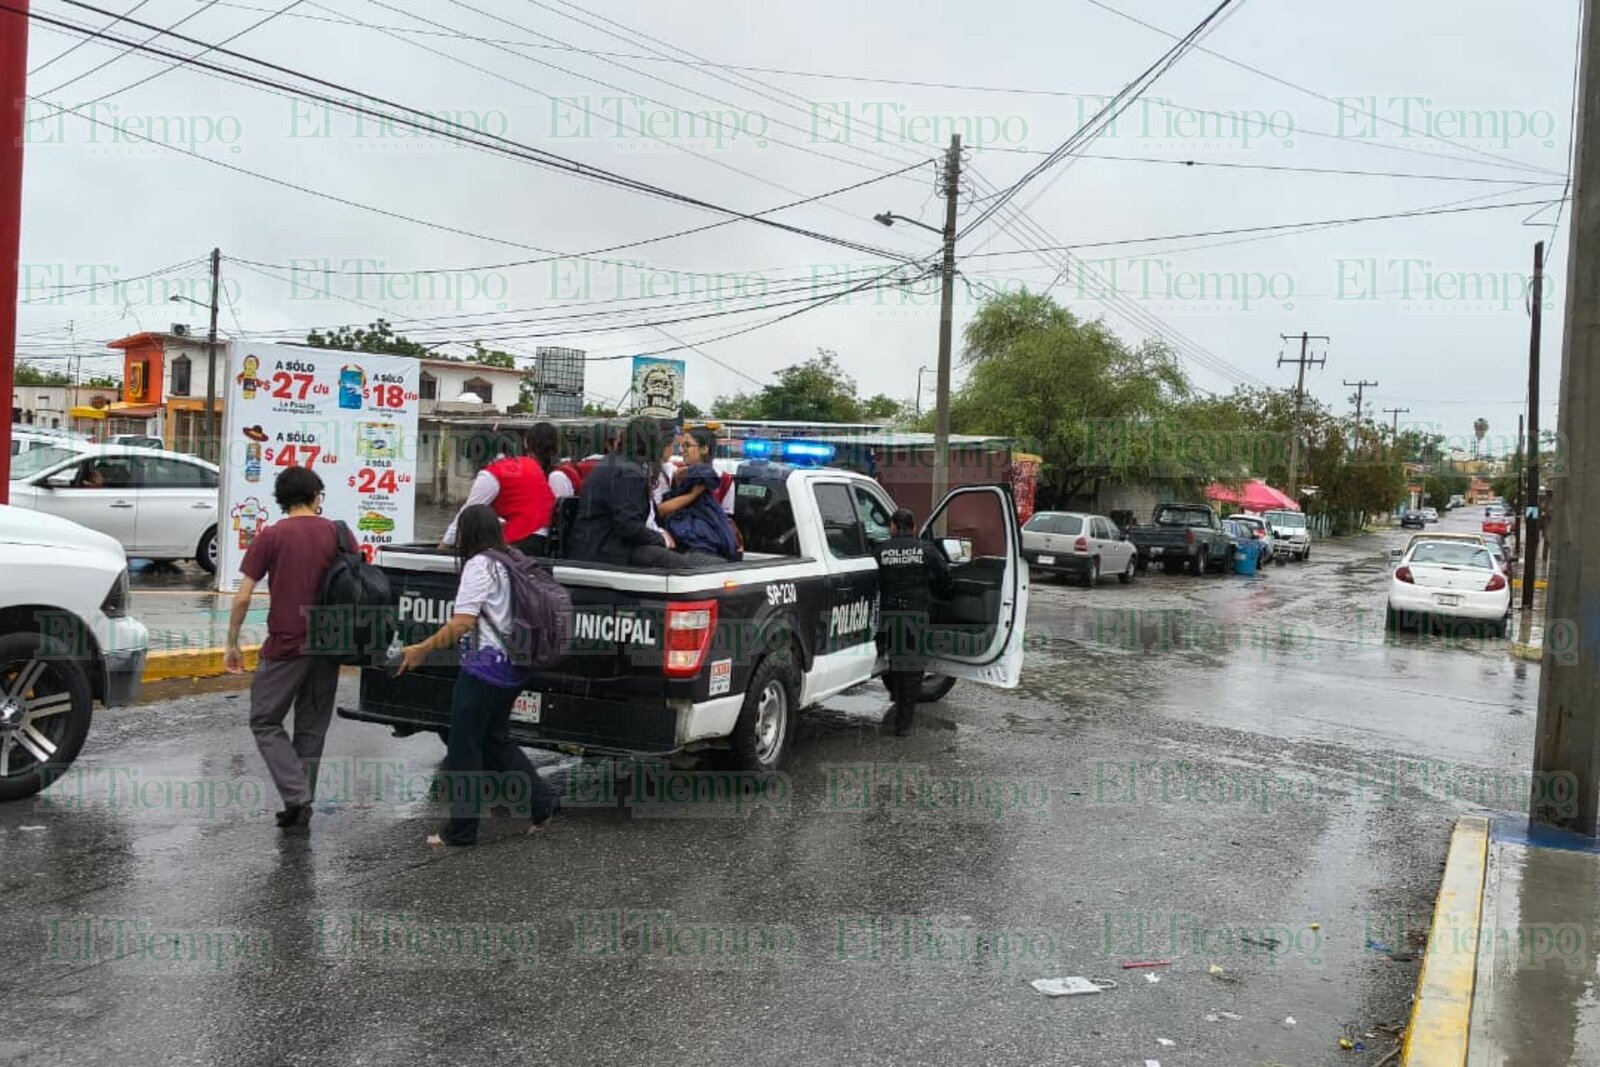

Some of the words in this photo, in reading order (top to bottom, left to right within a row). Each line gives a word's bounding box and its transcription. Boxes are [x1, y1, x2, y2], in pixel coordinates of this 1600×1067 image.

[275, 361, 283, 370] A
[286, 360, 315, 372] SÓLO
[373, 374, 379, 382] A
[313, 384, 329, 395] c/u
[277, 433, 284, 441] A
[323, 453, 337, 463] c/u
[363, 535, 370, 543] A
[881, 547, 924, 557] POLICÍA
[881, 556, 925, 564] MUNICIPAL
[398, 597, 456, 624] POLIC
[575, 613, 656, 645] NICIPAL
[830, 596, 869, 637] POLICÍA
